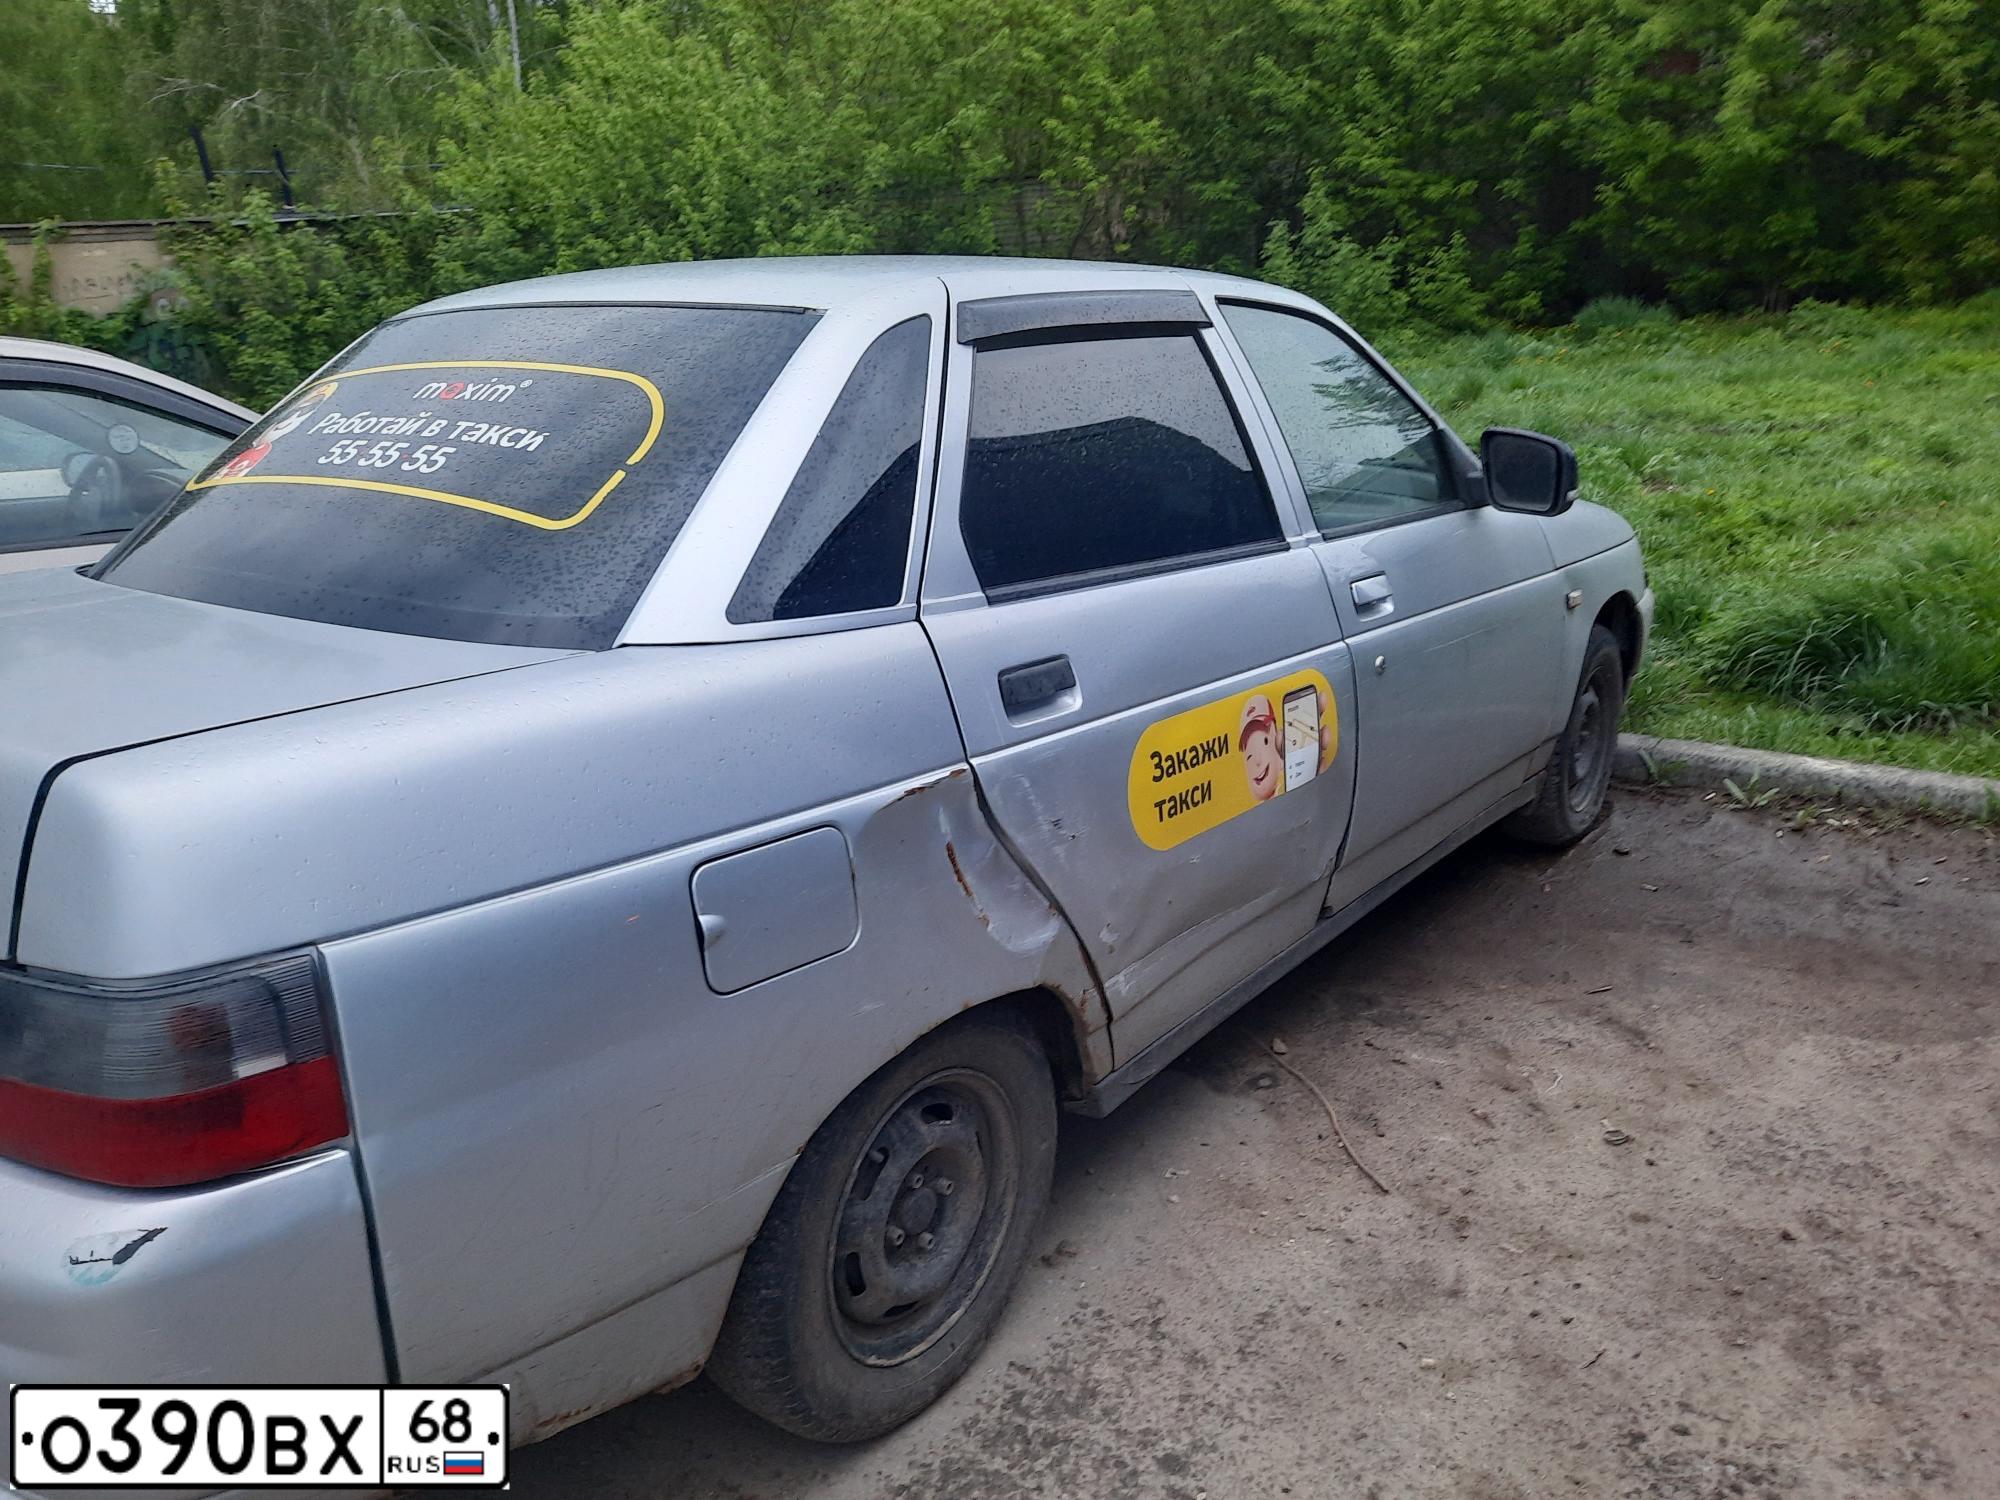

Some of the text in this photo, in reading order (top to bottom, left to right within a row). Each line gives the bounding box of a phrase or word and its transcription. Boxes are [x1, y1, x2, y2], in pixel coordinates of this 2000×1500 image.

[306, 411, 550, 452] Работай в такси
[1149, 733, 1230, 783] Закажи
[1153, 779, 1213, 823] такси
